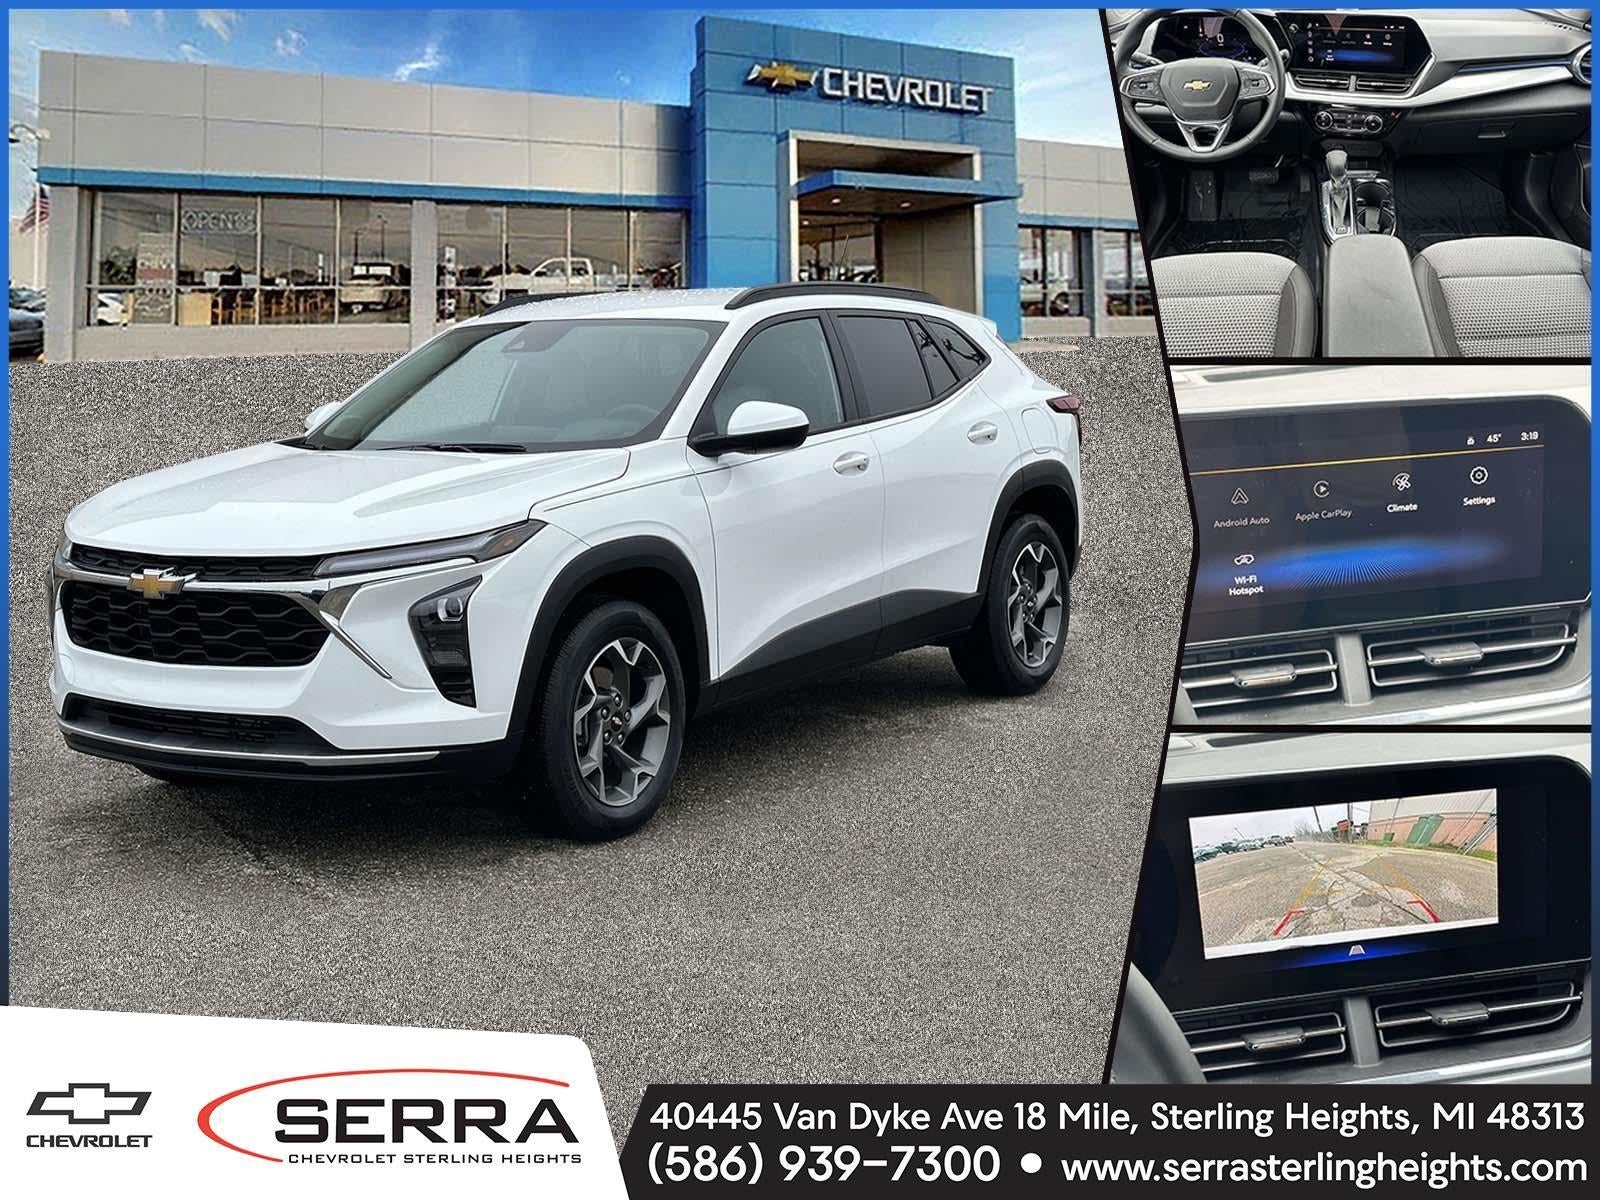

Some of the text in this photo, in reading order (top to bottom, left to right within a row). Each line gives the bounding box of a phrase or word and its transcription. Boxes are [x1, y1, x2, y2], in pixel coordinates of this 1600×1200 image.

[823, 66, 993, 112] CHEVROLET
[1520, 431, 1539, 441] 3:19
[1463, 496, 1496, 506] Settings
[1386, 503, 1418, 513] Climate
[1295, 508, 1352, 522] Apple CarPlay
[1213, 516, 1270, 528] Android Auto
[1234, 575, 1257, 585] Wi-Fi
[1229, 585, 1264, 596] Hotspot
